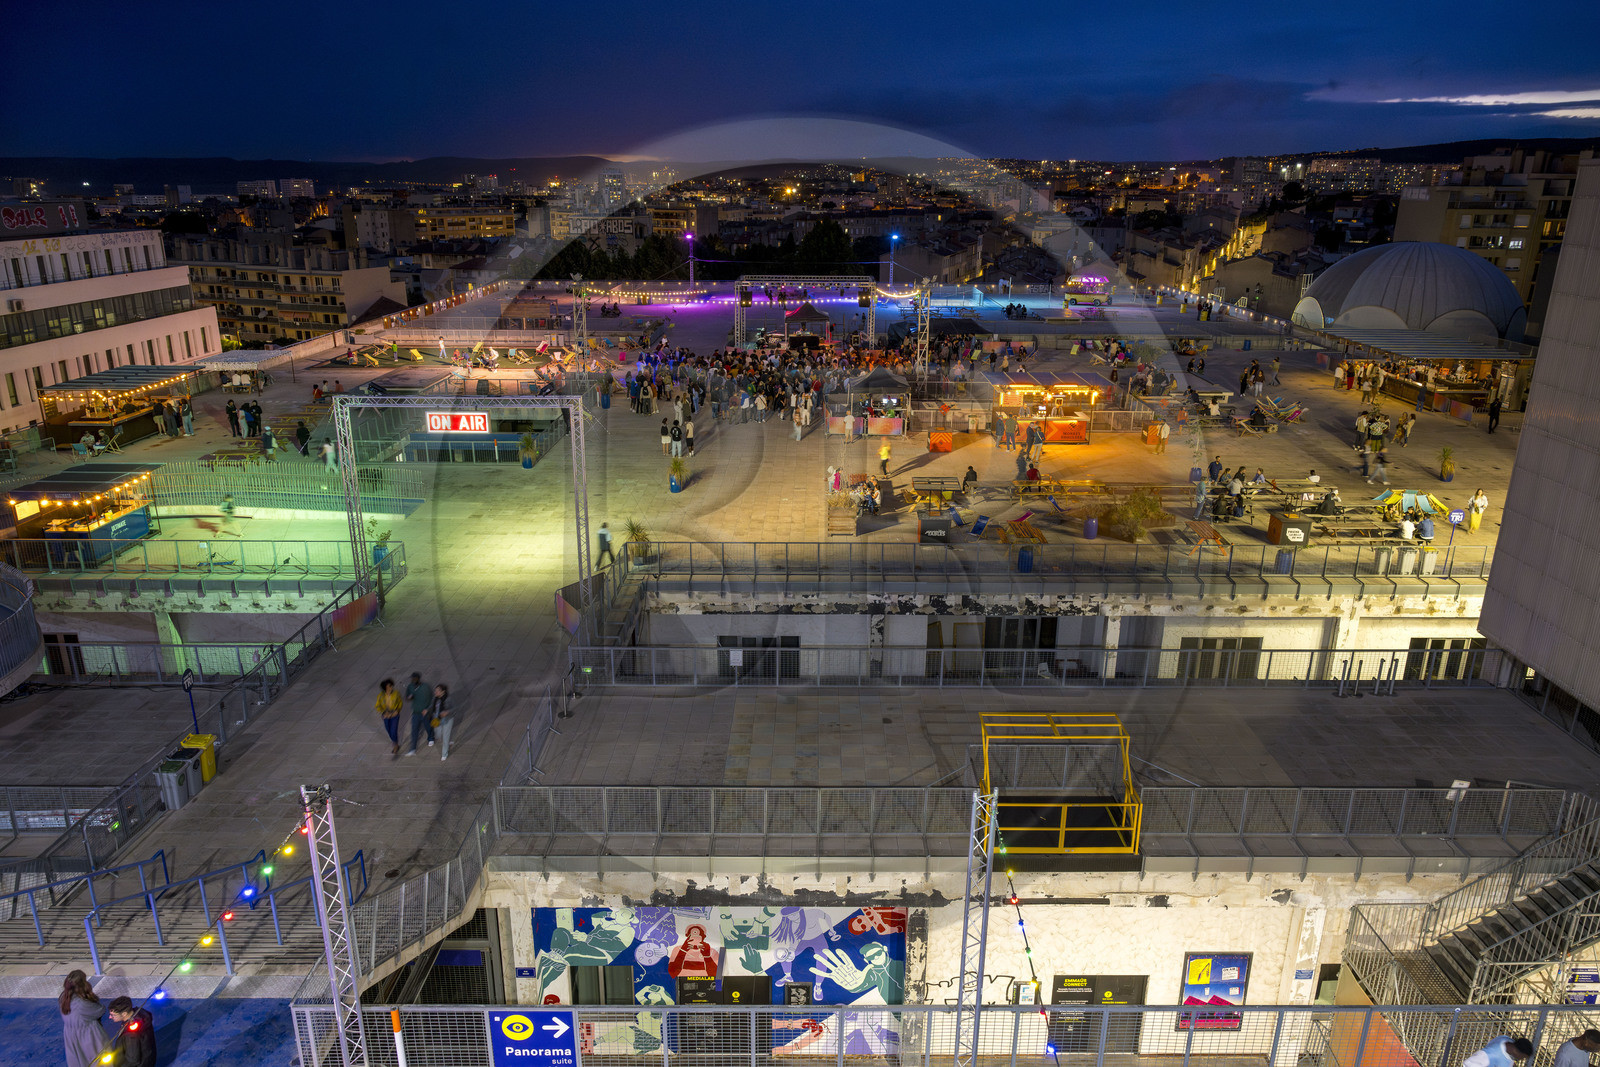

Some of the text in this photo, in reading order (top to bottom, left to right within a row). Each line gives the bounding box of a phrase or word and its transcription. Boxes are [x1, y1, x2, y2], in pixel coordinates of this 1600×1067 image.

[430, 415, 485, 430] ON AIR
[1450, 514, 1464, 522] TRI
[505, 1047, 572, 1056] Panorama
